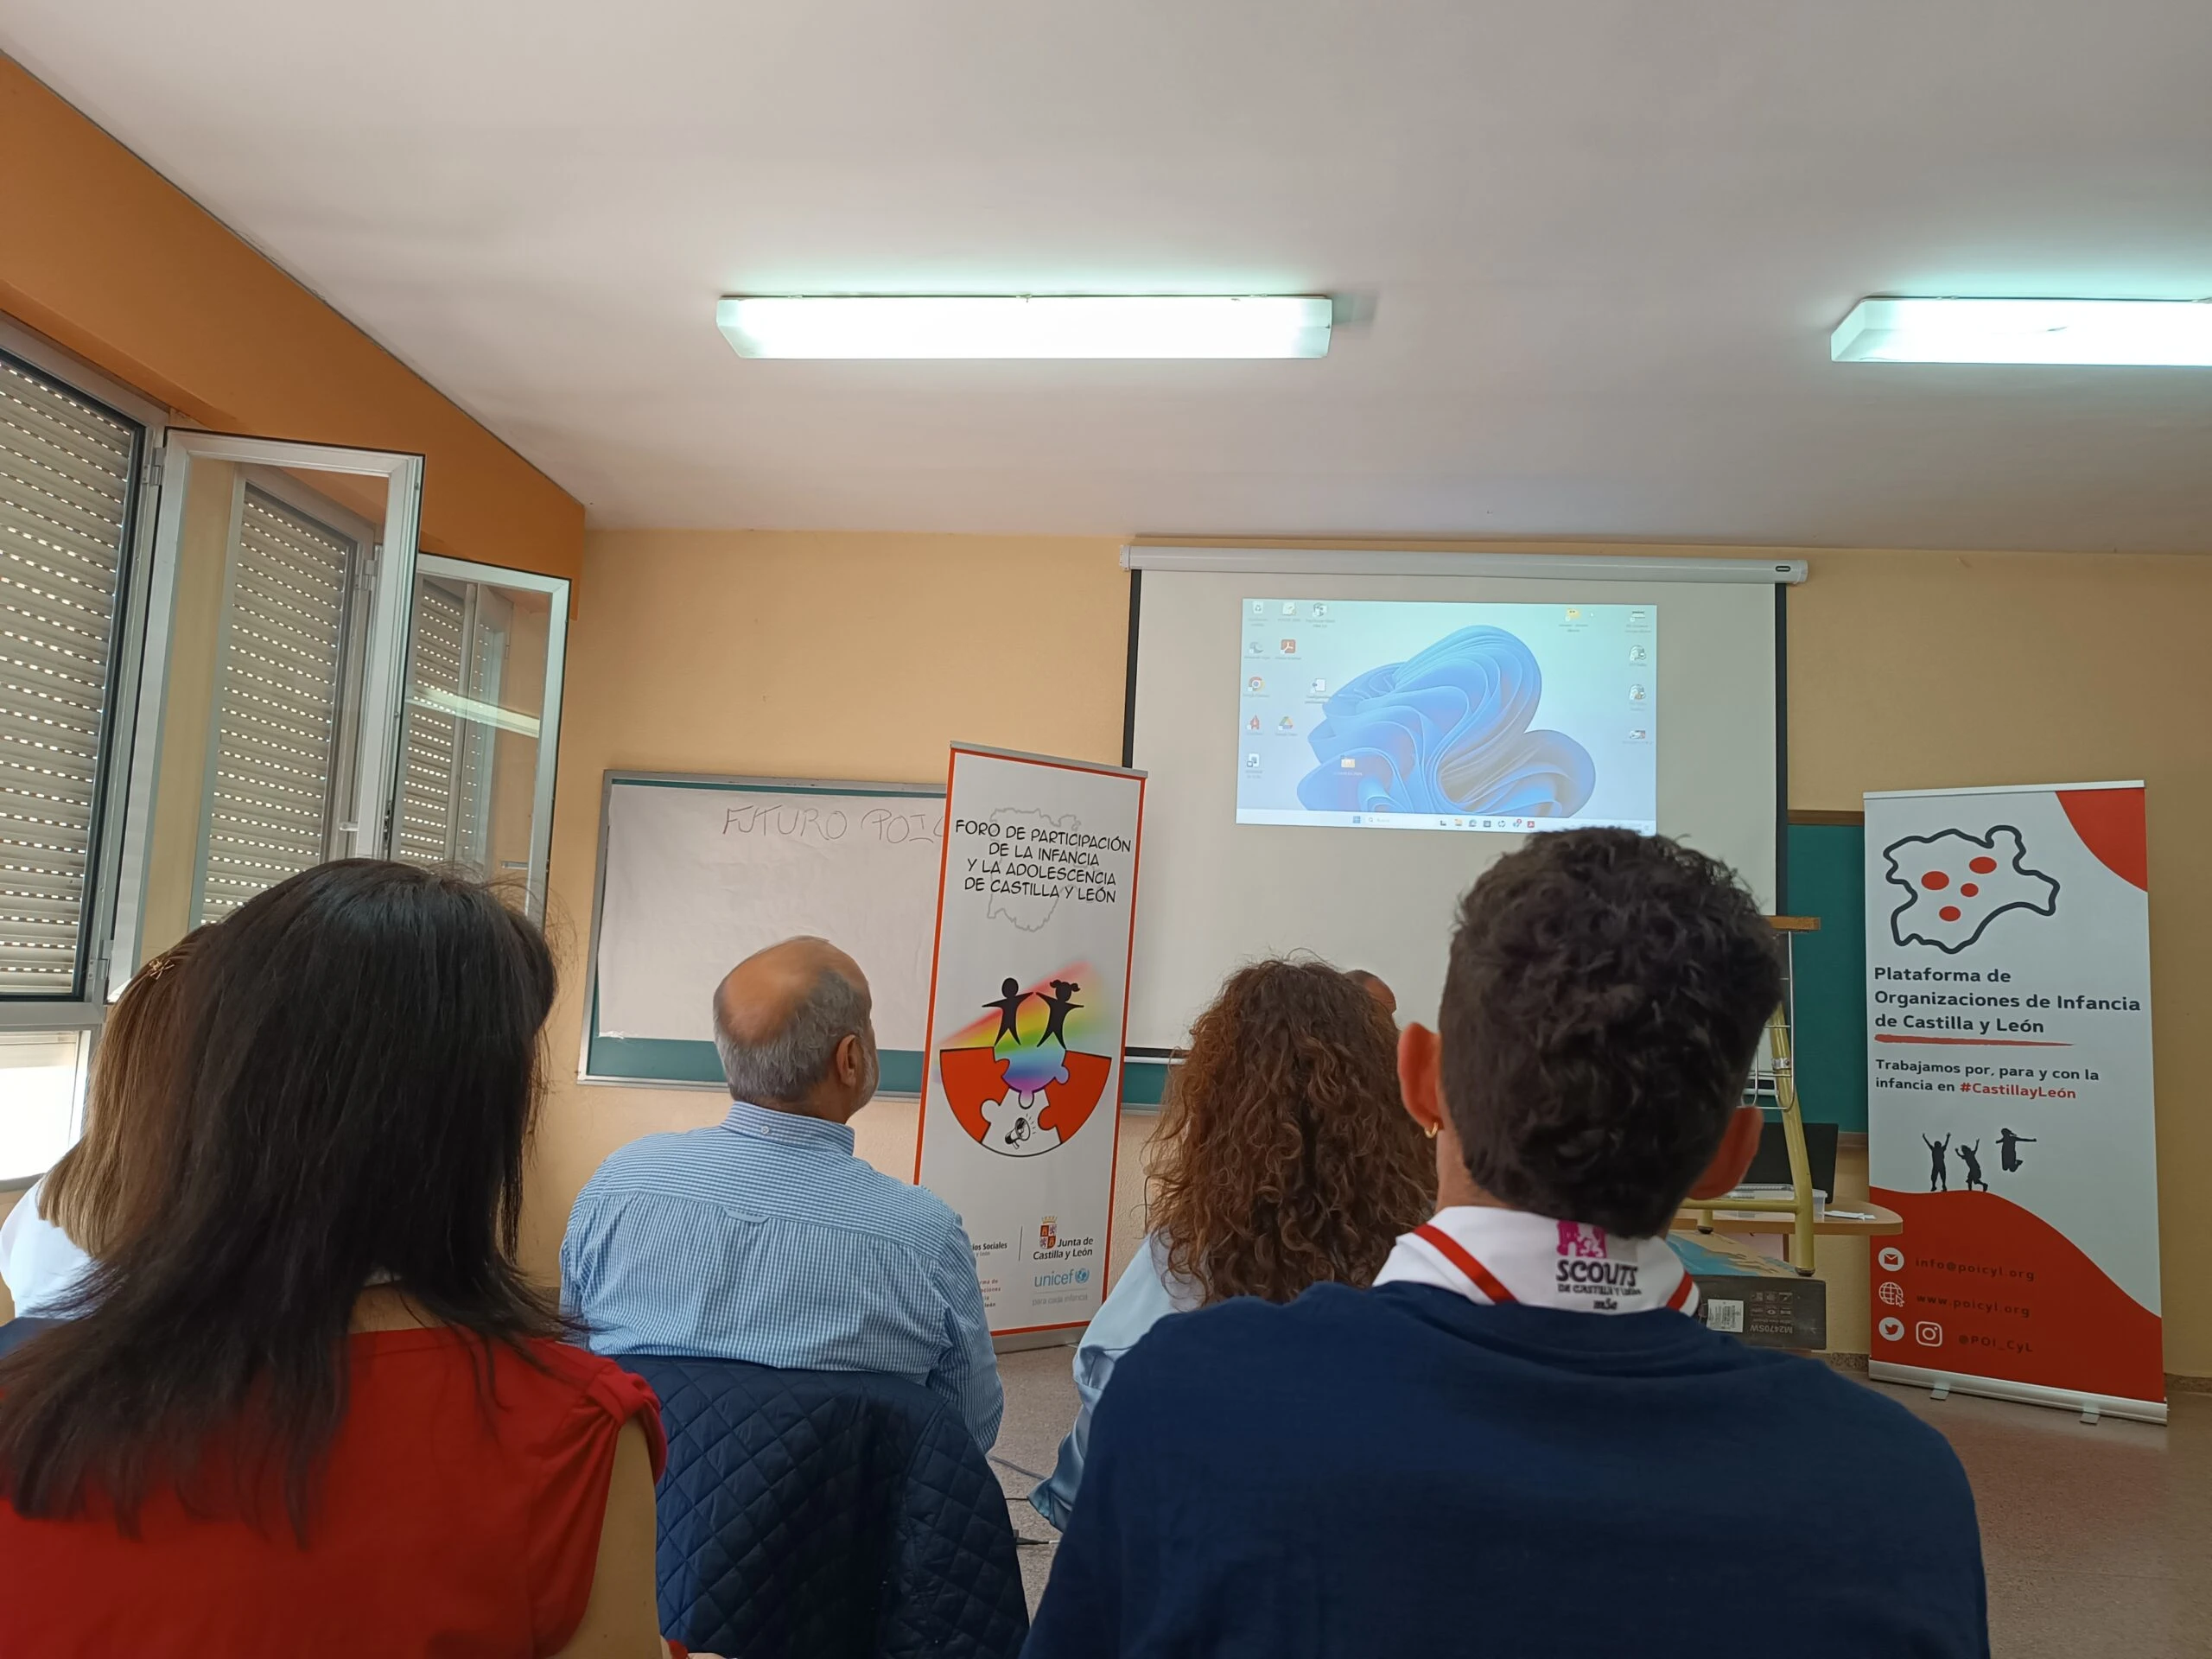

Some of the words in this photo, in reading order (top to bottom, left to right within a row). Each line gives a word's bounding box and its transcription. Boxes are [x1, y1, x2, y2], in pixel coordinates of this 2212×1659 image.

[723, 804, 848, 841] FUTURO
[956, 820, 1000, 837] FORO
[1006, 826, 1026, 840] DE
[1031, 829, 1131, 853] PARTICIPACIÓN
[989, 842, 1009, 856] DE
[1015, 845, 1033, 859] LA
[1039, 848, 1099, 867] INFANCIA
[967, 859, 977, 872] Y
[982, 861, 1001, 874] LA
[1006, 863, 1116, 886] ADOLESCENCIA
[964, 877, 984, 891] DE
[990, 880, 1059, 898] CASTILLA
[1065, 887, 1073, 899] Y
[1078, 888, 1116, 903] LEÓN
[1874, 967, 1980, 982] Plataforma
[1987, 969, 2012, 982] de
[1874, 991, 2020, 1008] Organizaciones
[2026, 995, 2050, 1008] de
[2057, 995, 2140, 1011] Infancia
[1875, 1014, 1897, 1027] de
[1903, 1015, 1974, 1031] Castilla
[1980, 1020, 1990, 1034] y
[1996, 1018, 2044, 1033] León
[1876, 1059, 1961, 1075] Trabajamos
[1965, 1064, 1994, 1077] por,
[1999, 1066, 2034, 1079] para
[2039, 1069, 2048, 1081] y
[2052, 1069, 2080, 1080] con
[2085, 1069, 2099, 1081] la
[1876, 1077, 1933, 1091] infancia
[1937, 1082, 1955, 1092] en
[1960, 1082, 2076, 1100] #CastillayLeón
[982, 1242, 1007, 1250] Sociales
[1058, 1238, 1081, 1248] Junta
[1083, 1236, 1094, 1245] de
[1033, 1250, 1063, 1260] Castilla
[1065, 1251, 1071, 1260] y
[1072, 1248, 1093, 1257] León
[1034, 1268, 1074, 1287] unicef
[1556, 1259, 1638, 1287] SCOUTS
[1916, 1257, 2035, 1281] info@poicyl.org
[1558, 1284, 1571, 1293] DE
[1916, 1295, 2031, 1318] www.poicyl.org
[1750, 1325, 1793, 1334] M2470SW
